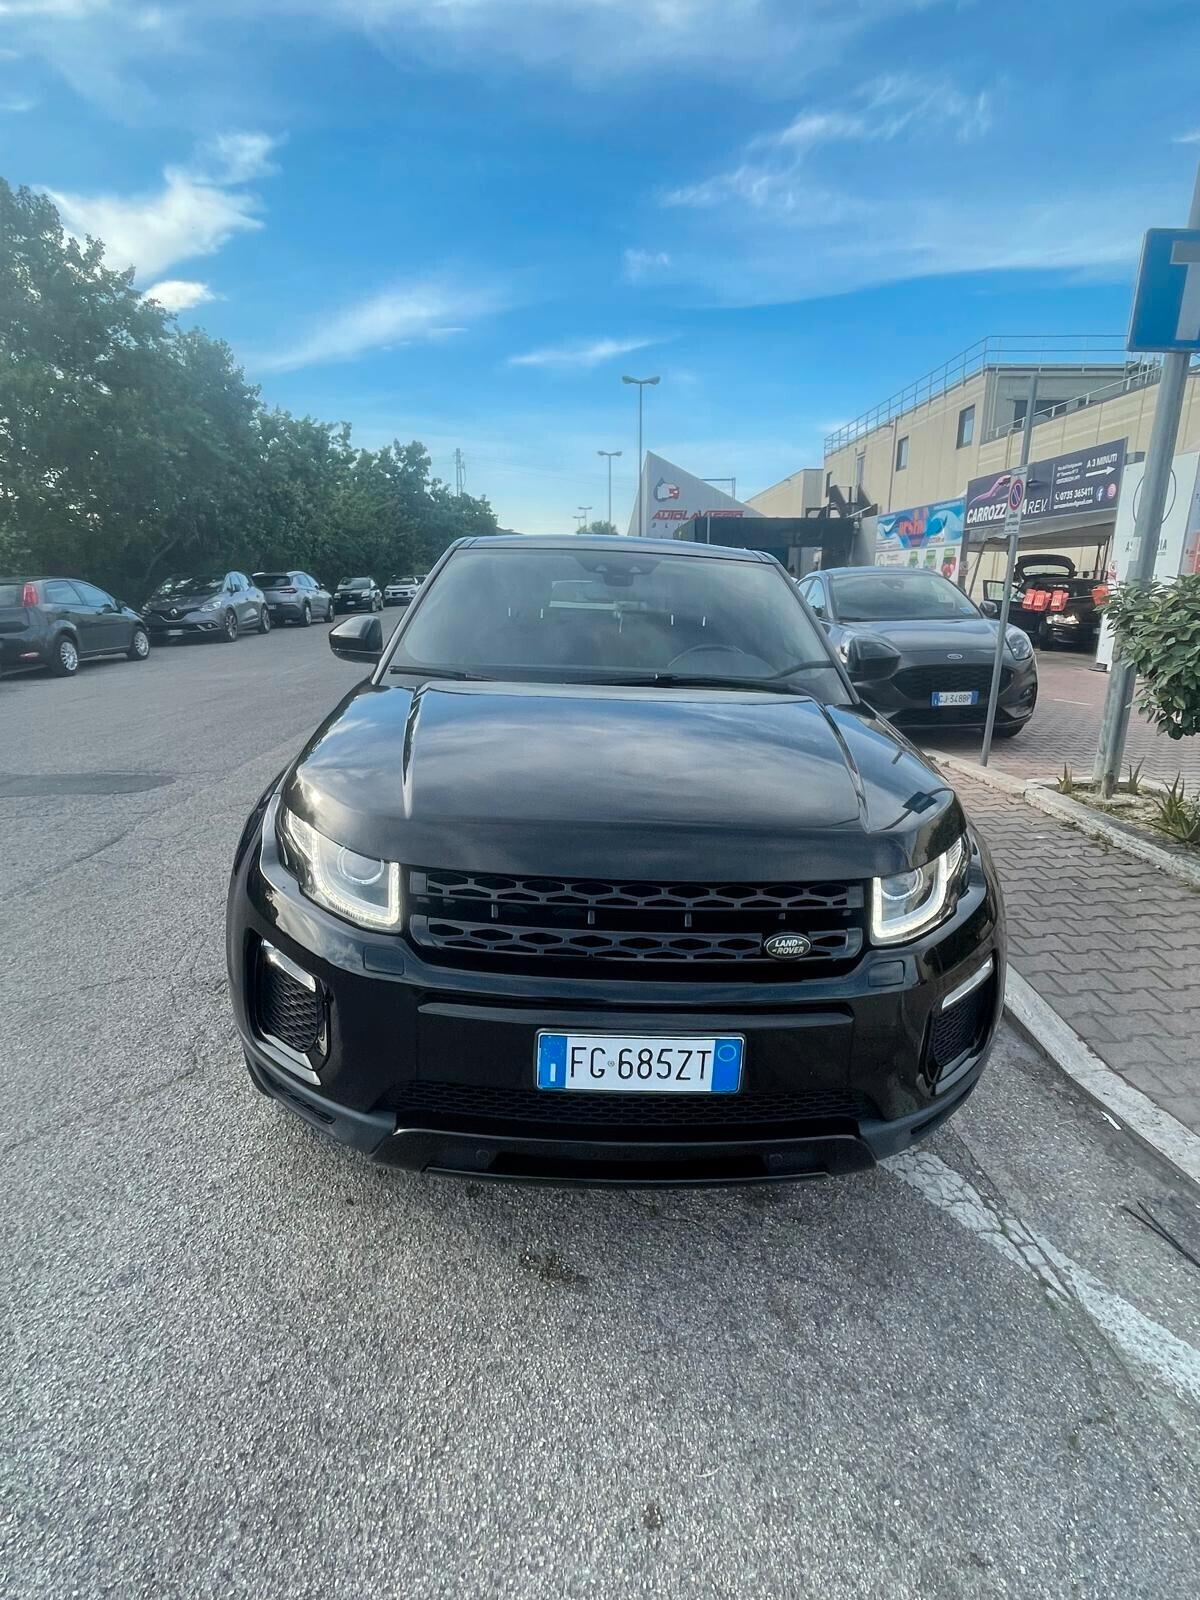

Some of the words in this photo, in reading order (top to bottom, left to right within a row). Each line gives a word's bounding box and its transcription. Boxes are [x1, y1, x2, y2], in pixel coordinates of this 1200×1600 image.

[1096, 453, 1118, 466] MINUTI
[1060, 490, 1073, 501] 0735
[775, 939, 798, 947] LAND
[777, 946, 804, 954] ROVER
